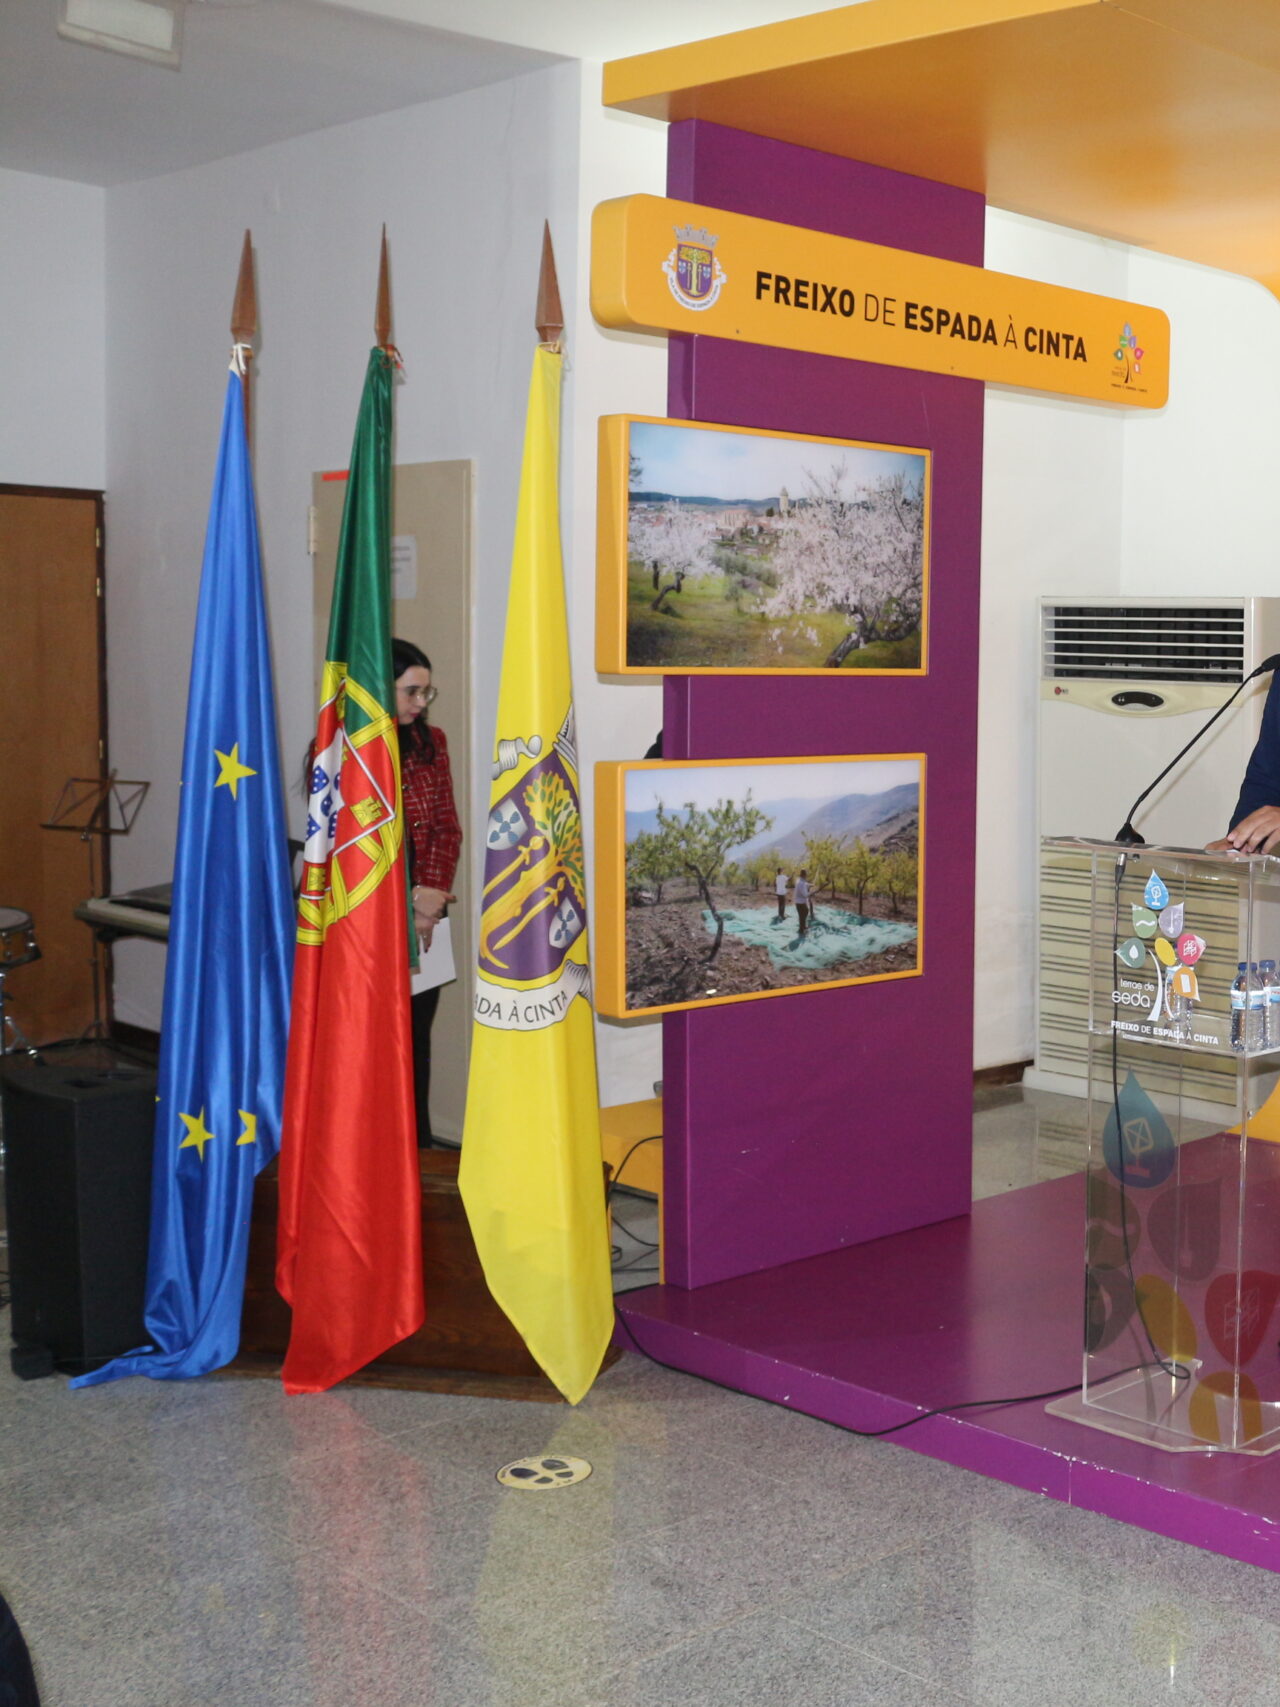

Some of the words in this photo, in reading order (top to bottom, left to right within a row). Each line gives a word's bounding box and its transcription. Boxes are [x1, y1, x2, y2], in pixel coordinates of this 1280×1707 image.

[756, 270, 855, 318] FREIXO
[864, 293, 897, 327] DE
[904, 301, 998, 346] ESPADA
[1003, 314, 1018, 350] À
[1024, 326, 1087, 363] CINTA
[1111, 991, 1151, 1008] seda
[1144, 982, 1155, 992] de
[508, 1000, 520, 1023] À
[524, 990, 568, 1023] CINTA
[1111, 1020, 1140, 1032] FREIXO
[1141, 1025, 1152, 1034] DE
[1193, 1033, 1219, 1045] CINTA
